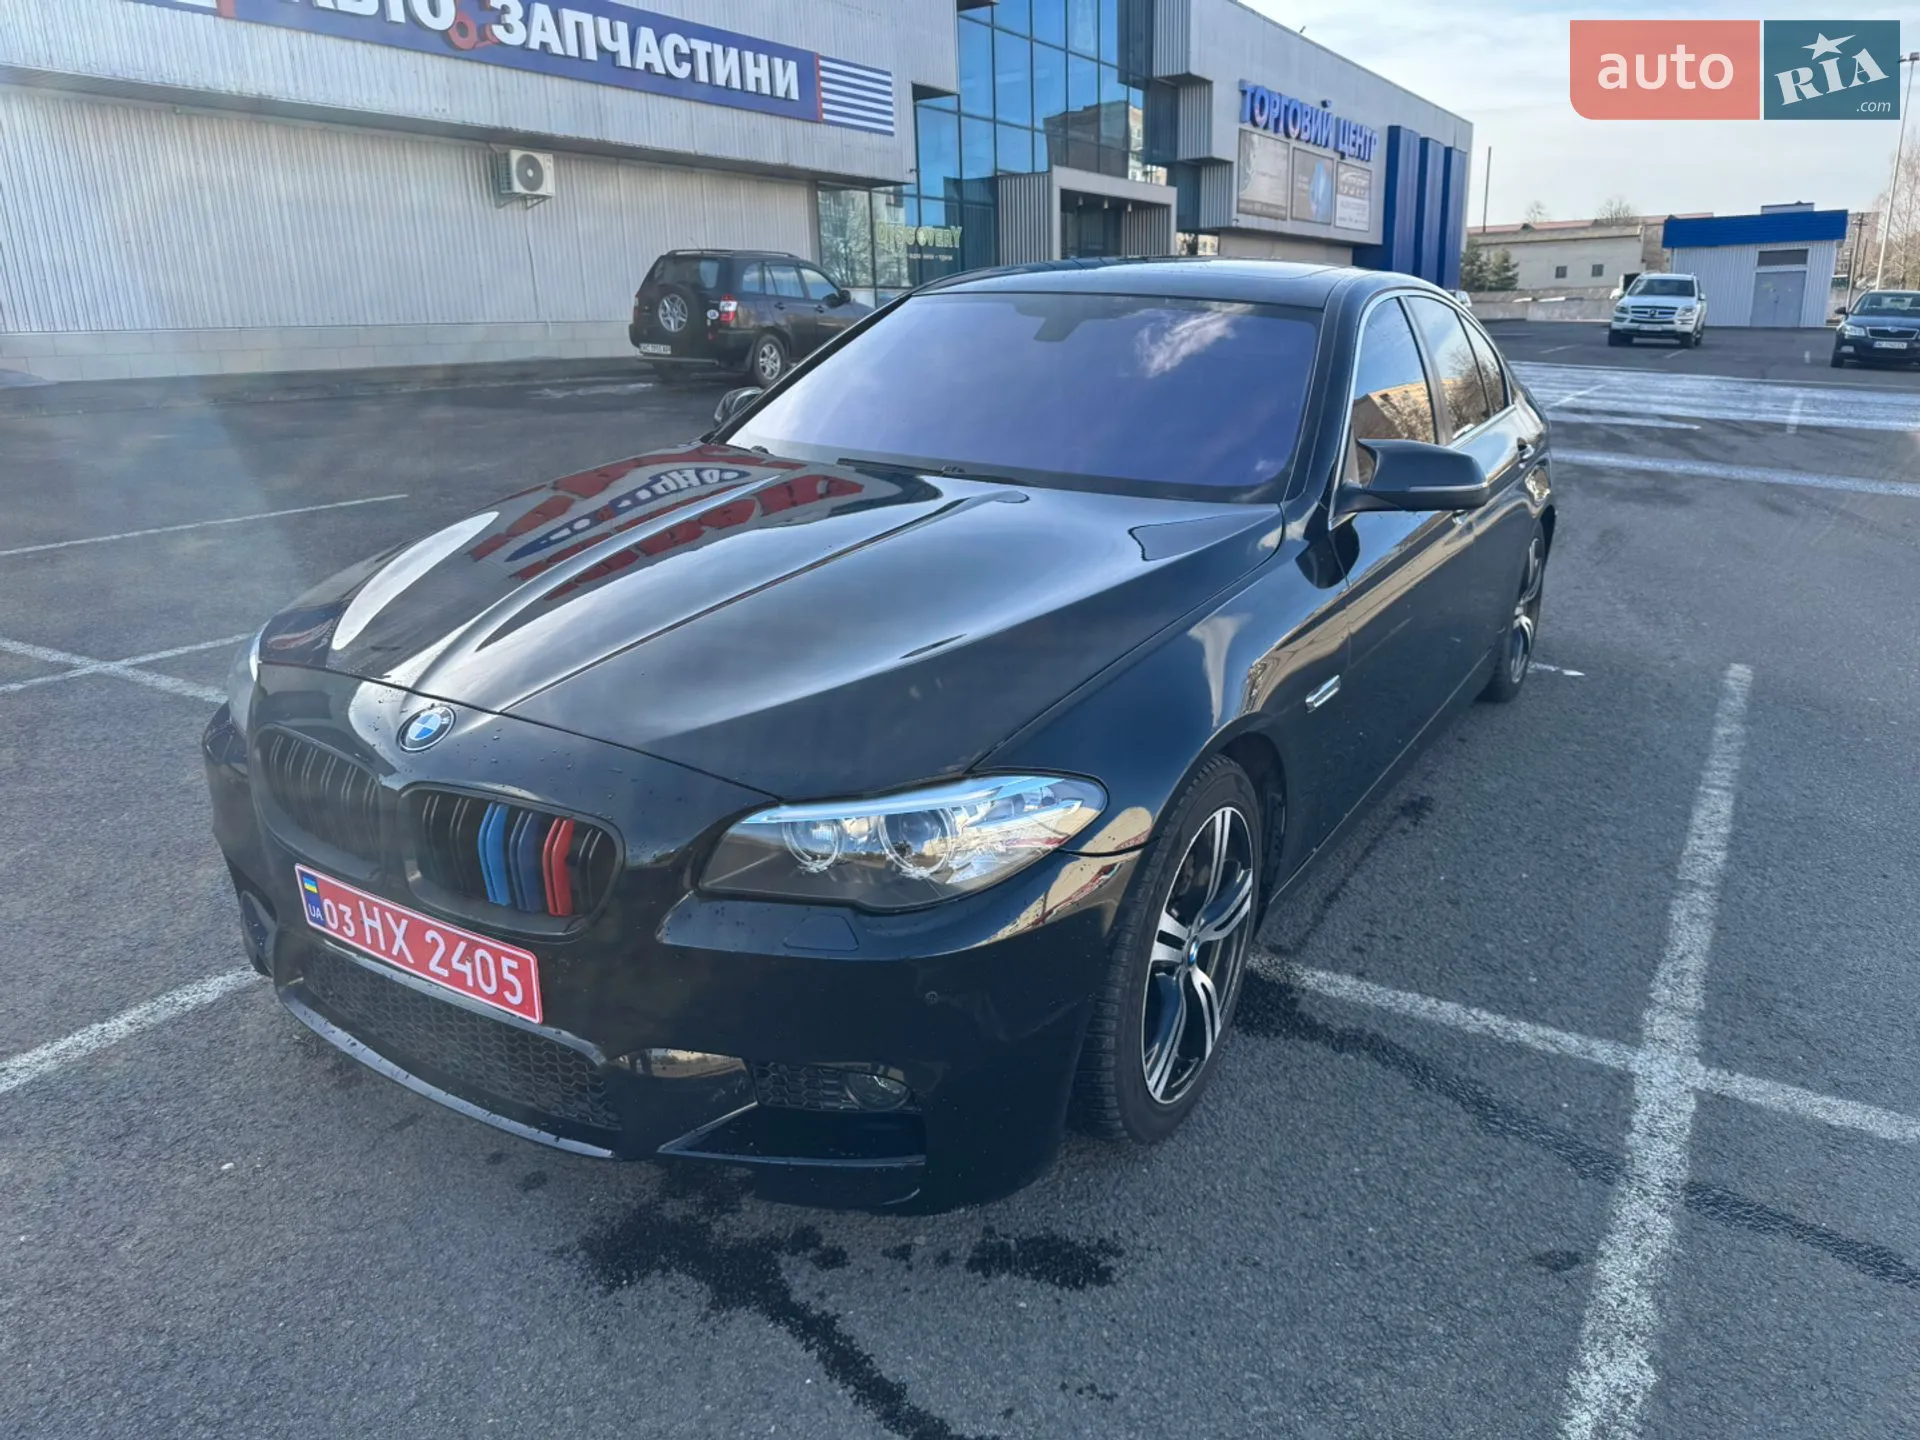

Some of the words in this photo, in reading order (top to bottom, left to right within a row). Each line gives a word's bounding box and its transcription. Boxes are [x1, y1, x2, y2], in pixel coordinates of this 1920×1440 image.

[490, 0, 800, 101] ЗАПЧАСТИНИ
[1238, 79, 1335, 150] ТОРГОВИЙ
[1335, 115, 1379, 162] ЦЕНТР
[875, 222, 963, 249] DISCOVERY
[308, 903, 324, 921] UA
[323, 898, 356, 938] 03
[358, 901, 414, 964] HX
[424, 929, 523, 1005] 2405
